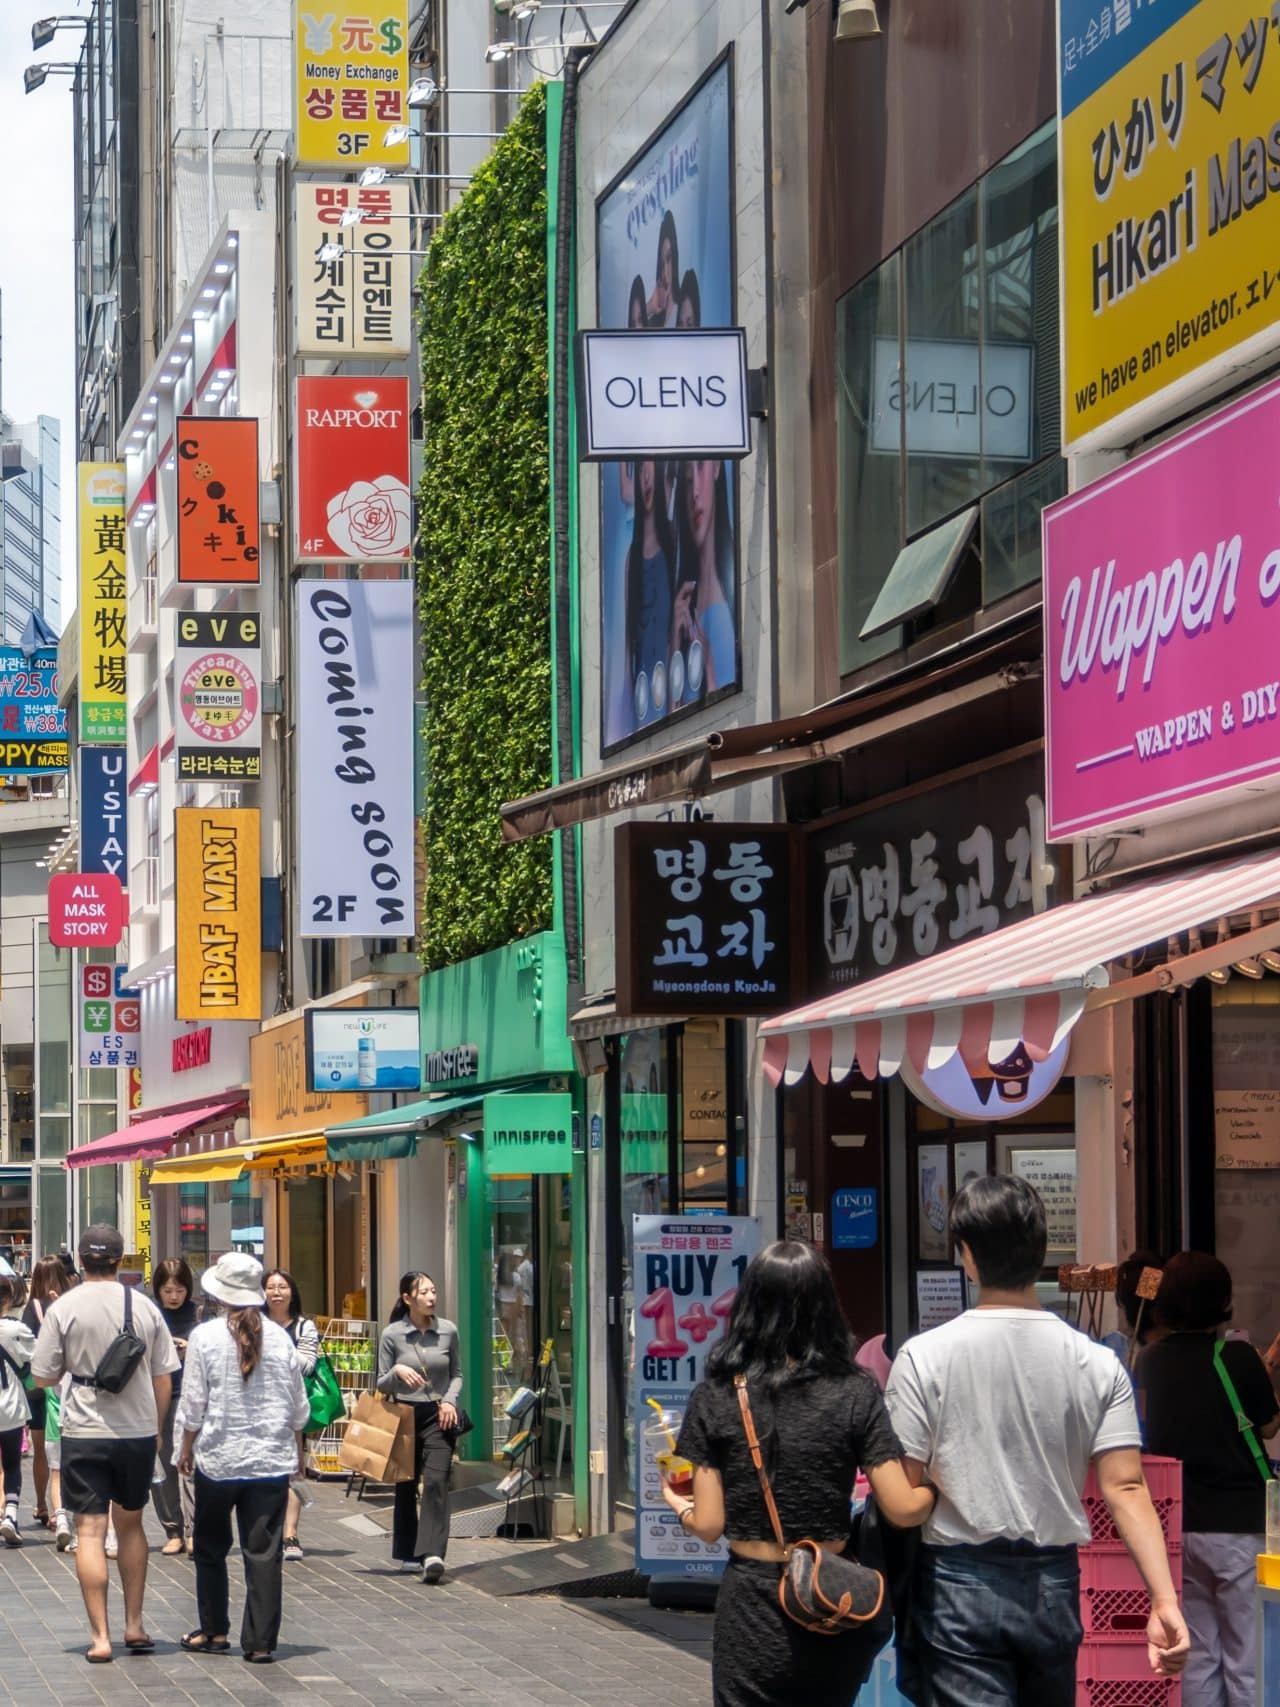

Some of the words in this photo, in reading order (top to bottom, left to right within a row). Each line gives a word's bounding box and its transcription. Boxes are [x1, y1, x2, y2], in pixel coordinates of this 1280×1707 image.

[306, 63, 341, 80] Money
[346, 64, 399, 81] Exchange
[305, 88, 402, 121] 상품권
[337, 133, 369, 155] 3F
[1092, 62, 1185, 199] ひかり
[315, 188, 393, 225] 명품
[1092, 169, 1197, 316] Hikari
[1075, 386, 1098, 414] we
[1100, 354, 1138, 398] have
[1142, 340, 1162, 374] an
[1166, 293, 1241, 358] elevator.
[605, 374, 727, 409] OLENS
[306, 409, 402, 429] RAPPORT
[304, 539, 324, 552] 4F
[1060, 534, 1243, 695] Wappen
[182, 618, 257, 642] eve
[184, 656, 255, 690] Threading
[201, 675, 235, 687] eve
[189, 710, 254, 740] Waxing
[1135, 706, 1213, 759] WAPPEN
[1221, 700, 1235, 731] &
[1242, 682, 1279, 725] DIY
[181, 756, 260, 775] 라라속눈썹
[310, 589, 376, 784] Coming
[351, 801, 405, 926] soon
[201, 819, 238, 912] MART
[653, 839, 774, 902] 명동
[860, 794, 1056, 966] 명동교자
[72, 886, 99, 898] ALL
[64, 903, 106, 917] MASK
[312, 895, 358, 923] 2F
[63, 922, 108, 936] STORY
[652, 909, 776, 971] 교자
[199, 923, 239, 1008] HBAF
[653, 979, 730, 995] Myeongdong
[734, 979, 777, 994] KyoJa
[103, 1036, 123, 1049] ES
[89, 1051, 137, 1065] 상품권
[646, 1254, 719, 1297] BUY
[643, 1355, 680, 1382] GET
[686, 1356, 696, 1382] 1
[685, 1564, 714, 1573] OLENS
